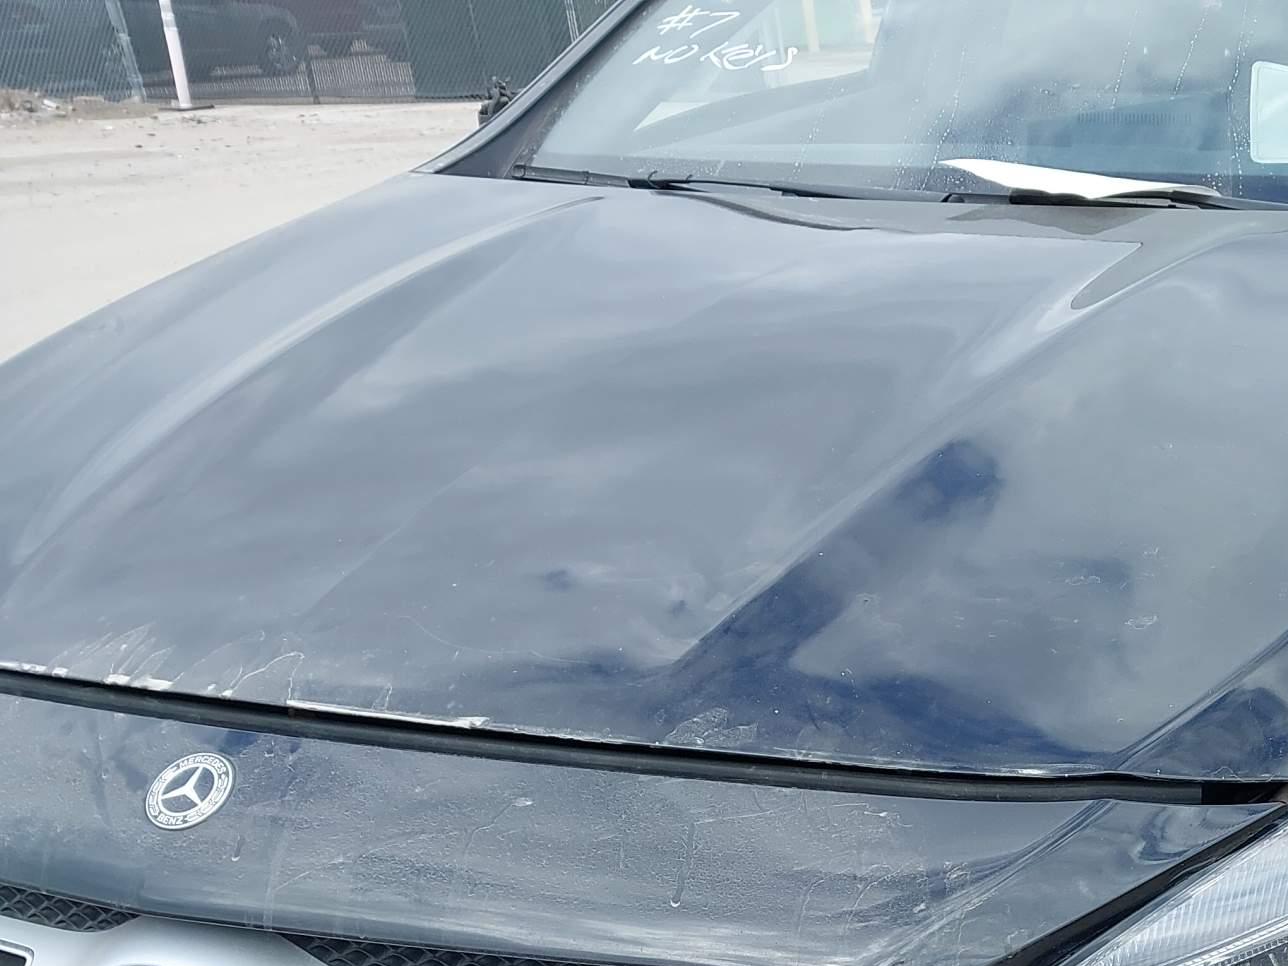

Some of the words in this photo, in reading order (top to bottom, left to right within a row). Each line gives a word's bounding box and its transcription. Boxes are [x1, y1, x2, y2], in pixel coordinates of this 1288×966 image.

[656, 5, 741, 39] #7
[179, 755, 227, 774] MERCEDES
[156, 815, 184, 825] BENZ
